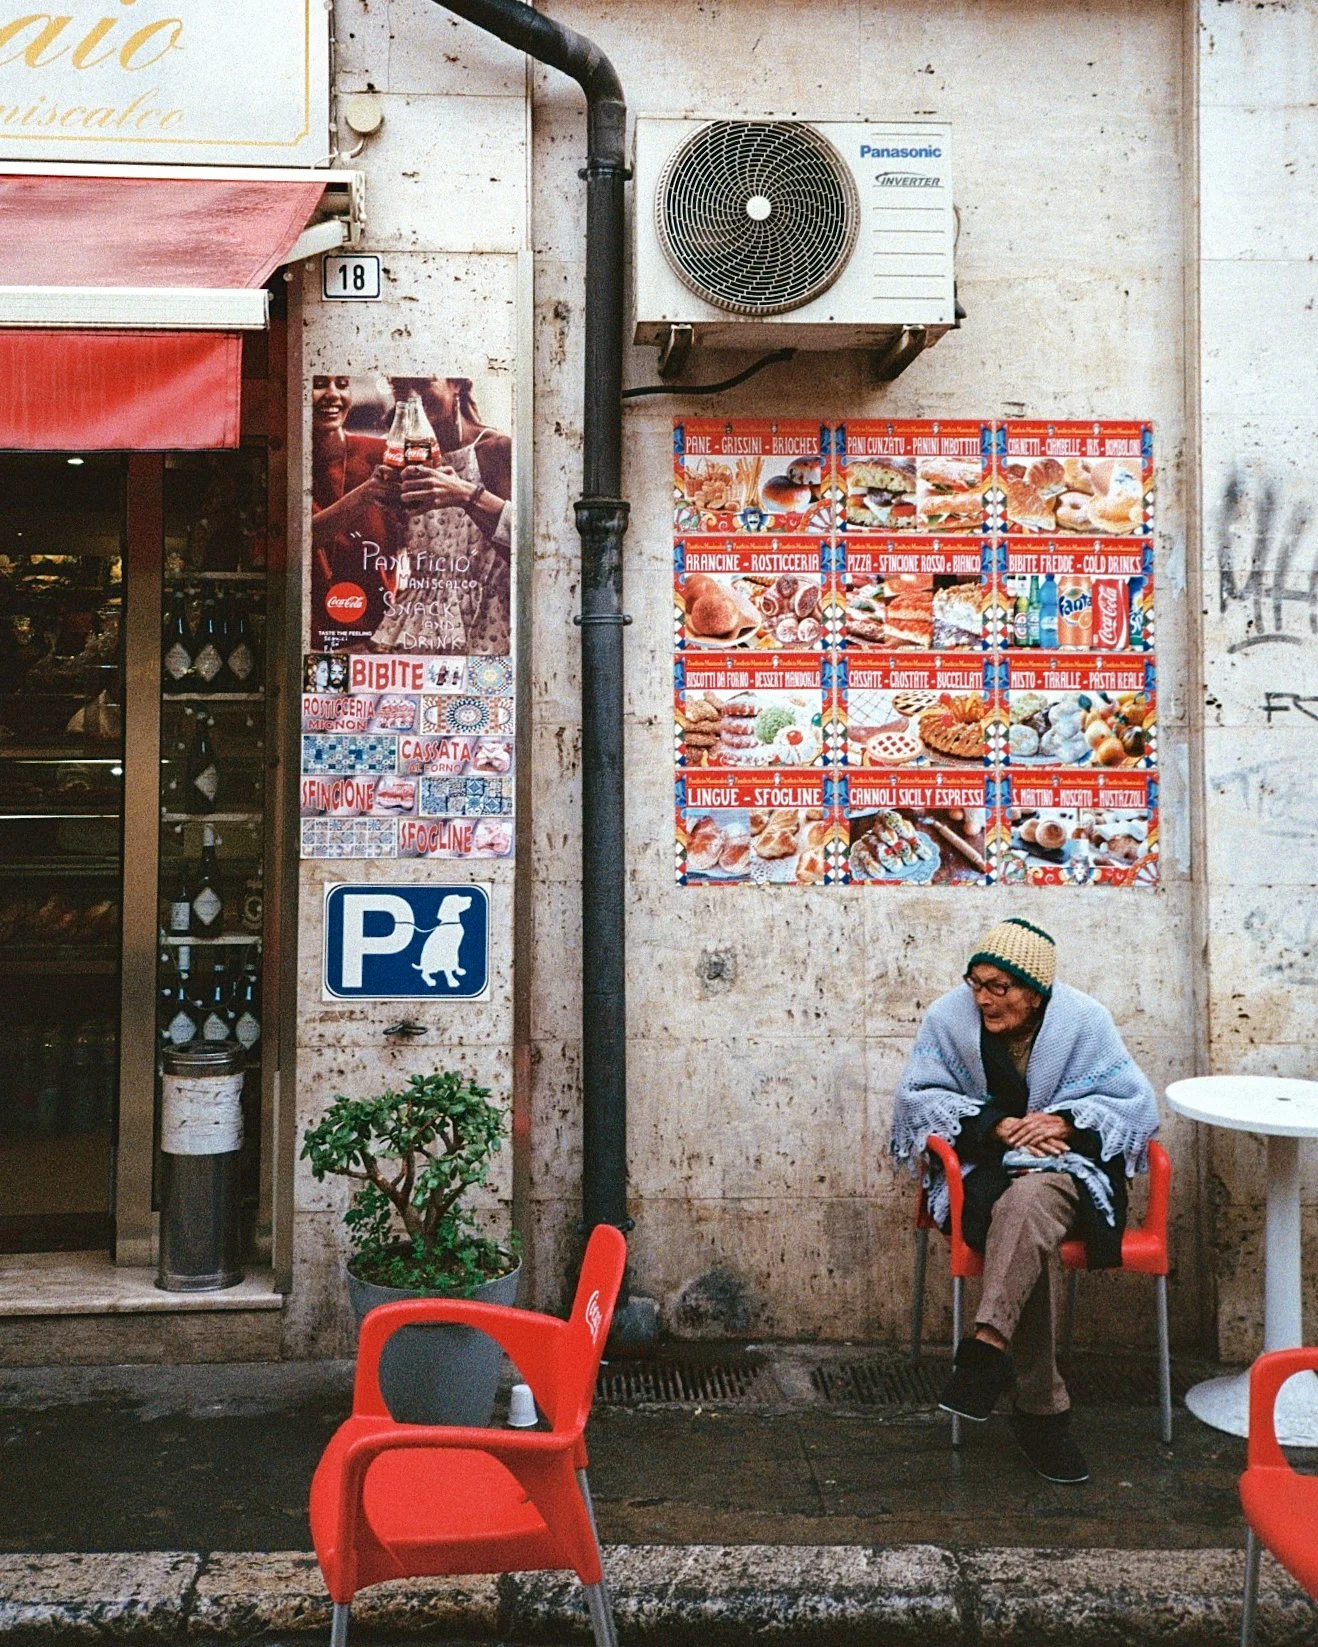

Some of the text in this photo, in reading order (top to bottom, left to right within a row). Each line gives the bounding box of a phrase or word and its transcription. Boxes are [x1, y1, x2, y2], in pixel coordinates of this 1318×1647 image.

[860, 144, 943, 159] Panasonic
[881, 176, 941, 187] INVERTER
[339, 264, 365, 290] 18
[685, 436, 818, 455] PANE GRISSINI BRIOCHES
[847, 437, 981, 455] PANI CUNZATU PANINI IMBOTTITI
[685, 553, 820, 571] ARANCINE ROSTICCERIA
[847, 554, 872, 572] PIZZA
[879, 554, 919, 572] SFINCIONE
[920, 554, 945, 572] ROSSO
[952, 554, 981, 572] BIANCO
[1008, 554, 1142, 573] BIBITE FREDDE COLD DRINKS
[327, 595, 365, 609] Coca-Cola
[403, 632, 464, 650] DRINK
[351, 658, 424, 691] BIBITE
[849, 671, 983, 689] CASSATE CROSTATE BUCCELLATI
[1010, 671, 1145, 690] MISTO TARALLE PASTA REALE
[303, 697, 376, 719] ROSTICCERIA
[307, 720, 368, 731] MIGNON
[400, 738, 472, 763] CASSATA
[302, 779, 375, 811] SFINCIONE
[687, 787, 823, 806] LINGUE SFOGLINE
[850, 788, 984, 806] CANNOLI SICILY ESPRESSI
[400, 821, 473, 854] SFOGLINE
[342, 894, 414, 988] P
